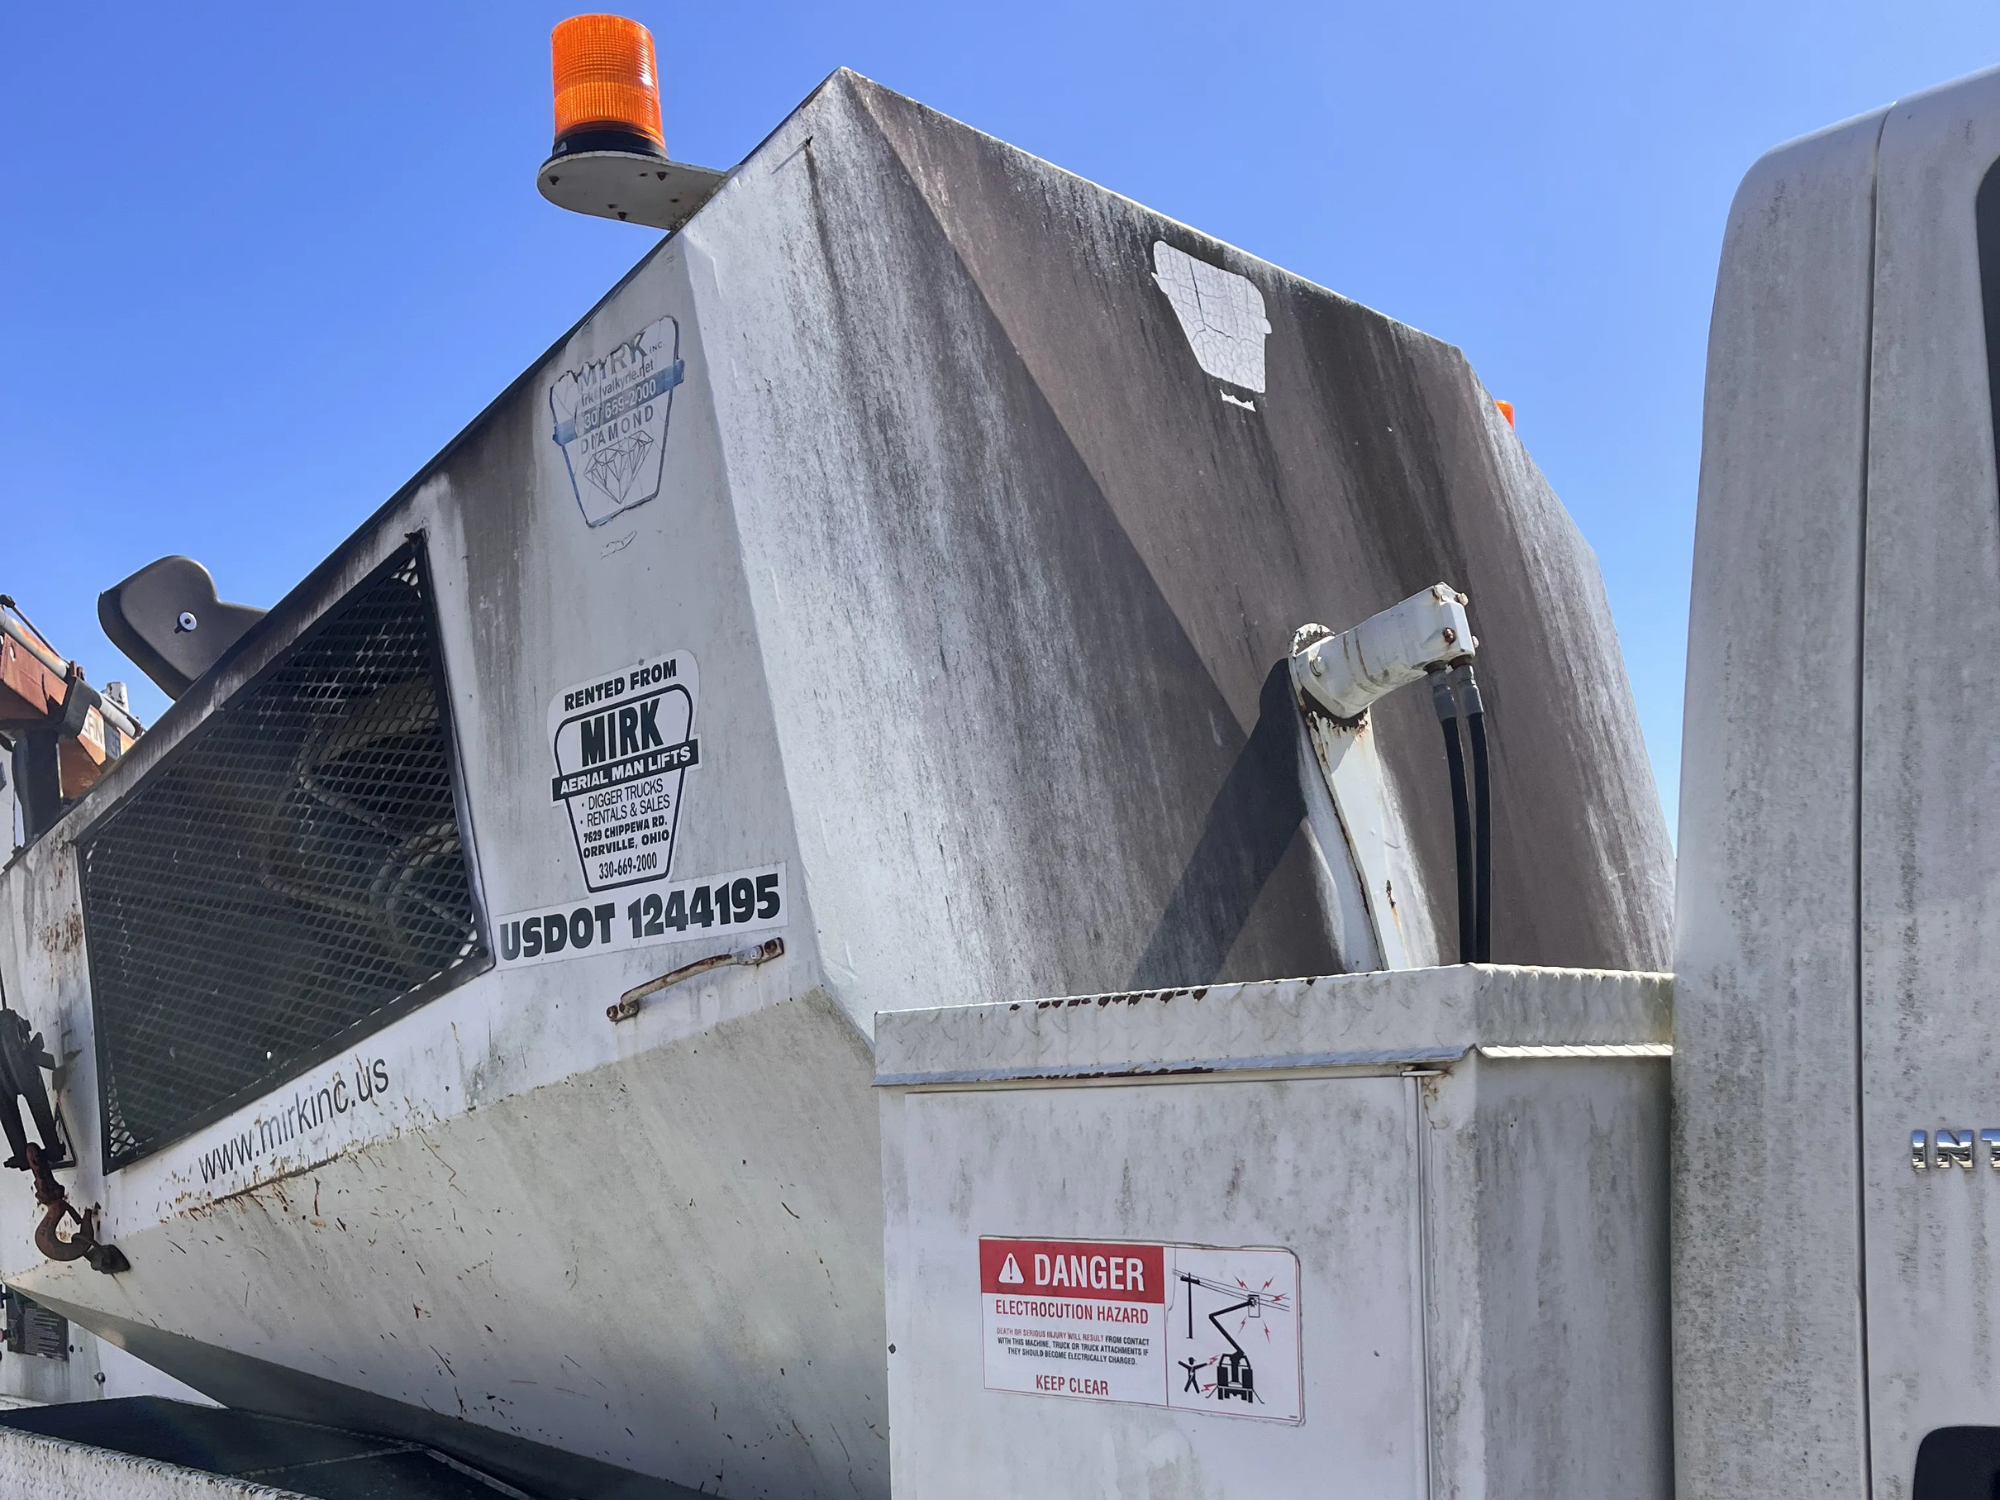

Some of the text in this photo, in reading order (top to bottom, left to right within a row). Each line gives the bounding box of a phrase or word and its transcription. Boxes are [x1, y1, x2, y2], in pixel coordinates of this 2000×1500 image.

[580, 405, 654, 454] DIAMOND
[564, 658, 677, 712] RENTED FROM
[580, 697, 664, 767] MIRK
[560, 746, 691, 794] AERIAL MAN LIFTS
[587, 793, 670, 827] RENTALS & SALES
[588, 778, 664, 810] DIGGER TRUCKS
[583, 814, 668, 844] 7629 CHIPPEWA RD.
[583, 829, 670, 858] ORRVILLE, OHIO
[599, 851, 658, 880] 330-669-2000
[499, 873, 781, 961] USDOT 1244195
[198, 1058, 389, 1184] www.mirkinc.us
[1034, 1253, 1145, 1292] DANGER
[996, 1300, 1149, 1324] ELECTROCUTION HAZARD
[996, 1327, 1149, 1346] DEATH OR SERIOUS INJURY WILL RESULT FROM CONTACT
[997, 1337, 1011, 1345] WITH
[1012, 1337, 1024, 1346] THIS
[1052, 1340, 1070, 1350] TRUCK
[1071, 1342, 1080, 1350] OR
[1080, 1343, 1100, 1352] TRUCK
[1100, 1345, 1142, 1356] ATTACHMENTS
[1143, 1348, 1149, 1356] IF
[1008, 1347, 1137, 1365] THEY SHOULD BECOME ELECTRICALLY CHARGED.
[1035, 1374, 1109, 1396] KEEP CLEAR
